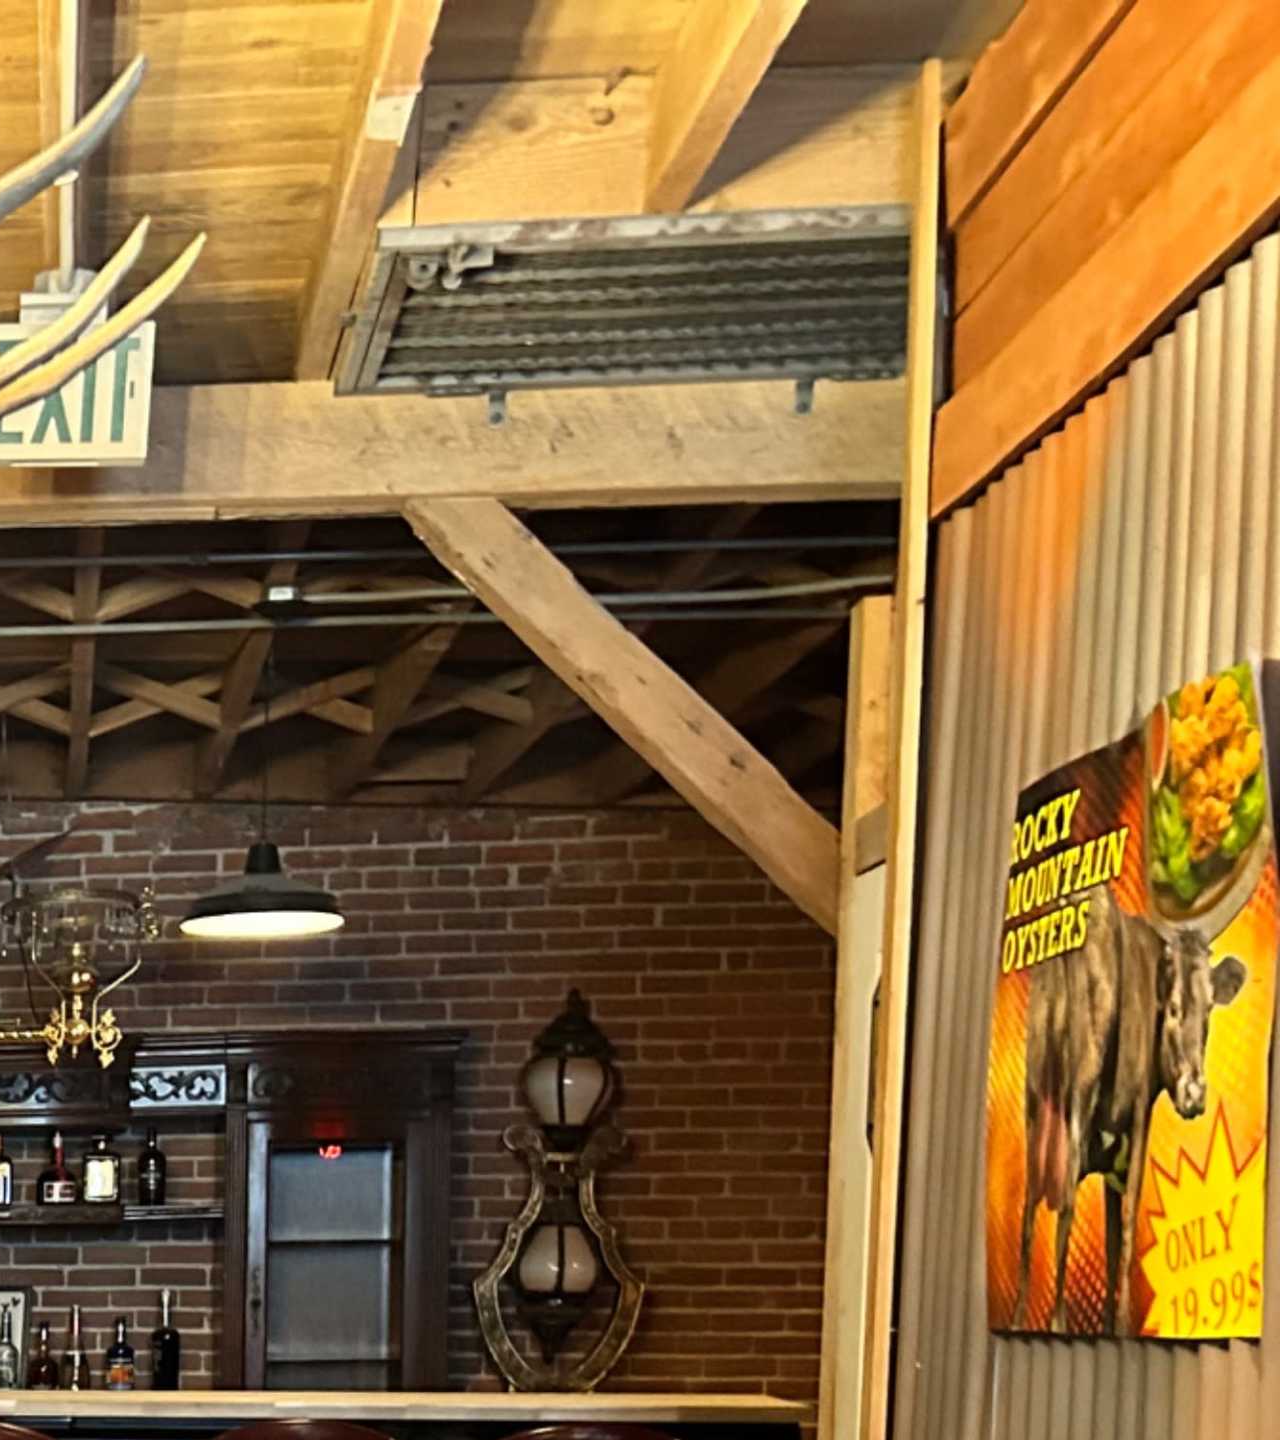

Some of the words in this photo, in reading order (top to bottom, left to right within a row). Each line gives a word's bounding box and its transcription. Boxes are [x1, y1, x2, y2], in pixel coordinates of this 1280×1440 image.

[1010, 788, 1081, 865] ROCKY
[1004, 826, 1129, 920] MOUNTAIN
[1002, 900, 1090, 974] OYSTERS
[1165, 1193, 1239, 1273] ONLY
